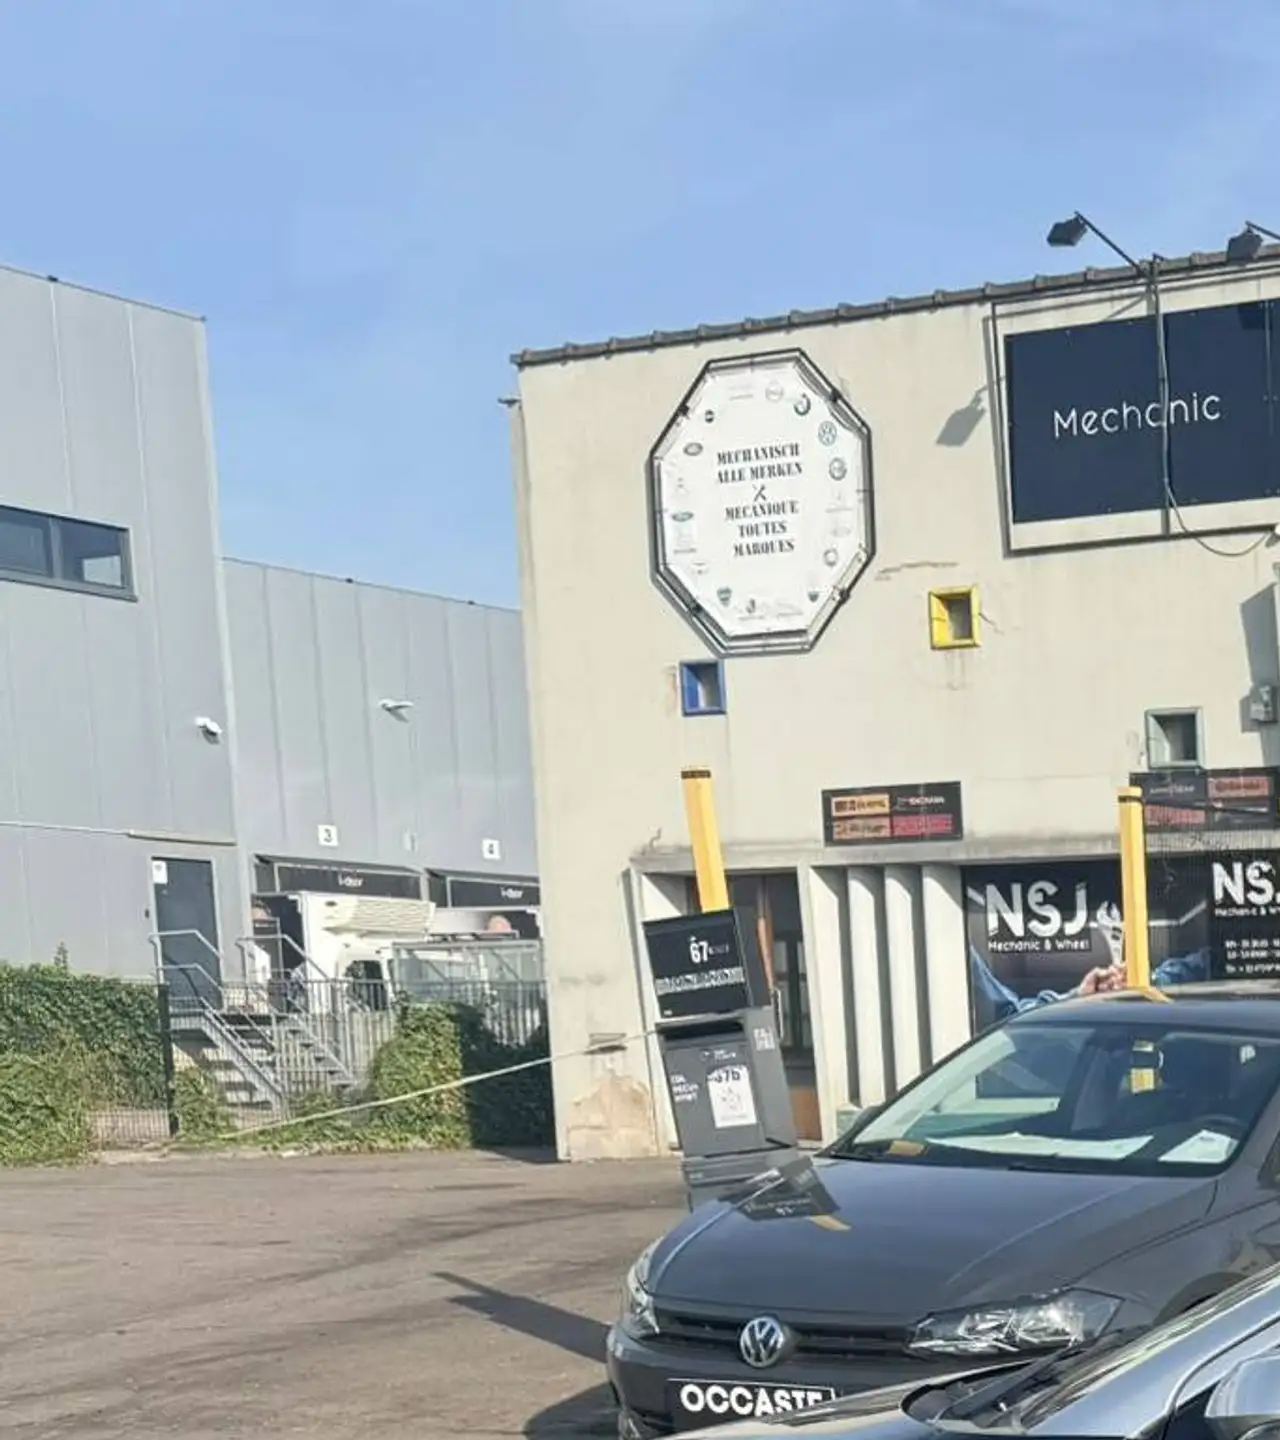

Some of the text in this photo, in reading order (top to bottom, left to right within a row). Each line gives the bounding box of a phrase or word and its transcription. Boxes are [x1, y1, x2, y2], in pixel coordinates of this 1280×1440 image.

[1053, 392, 1221, 439] Mechanic
[717, 443, 800, 465] MECHANISCH
[718, 462, 803, 484] ALLE MERKEN
[738, 520, 787, 538] TOUTES
[733, 539, 796, 557] MARQUES
[986, 880, 1088, 937] NSJ
[689, 941, 709, 963] 67
[987, 939, 1041, 952] Mechanic
